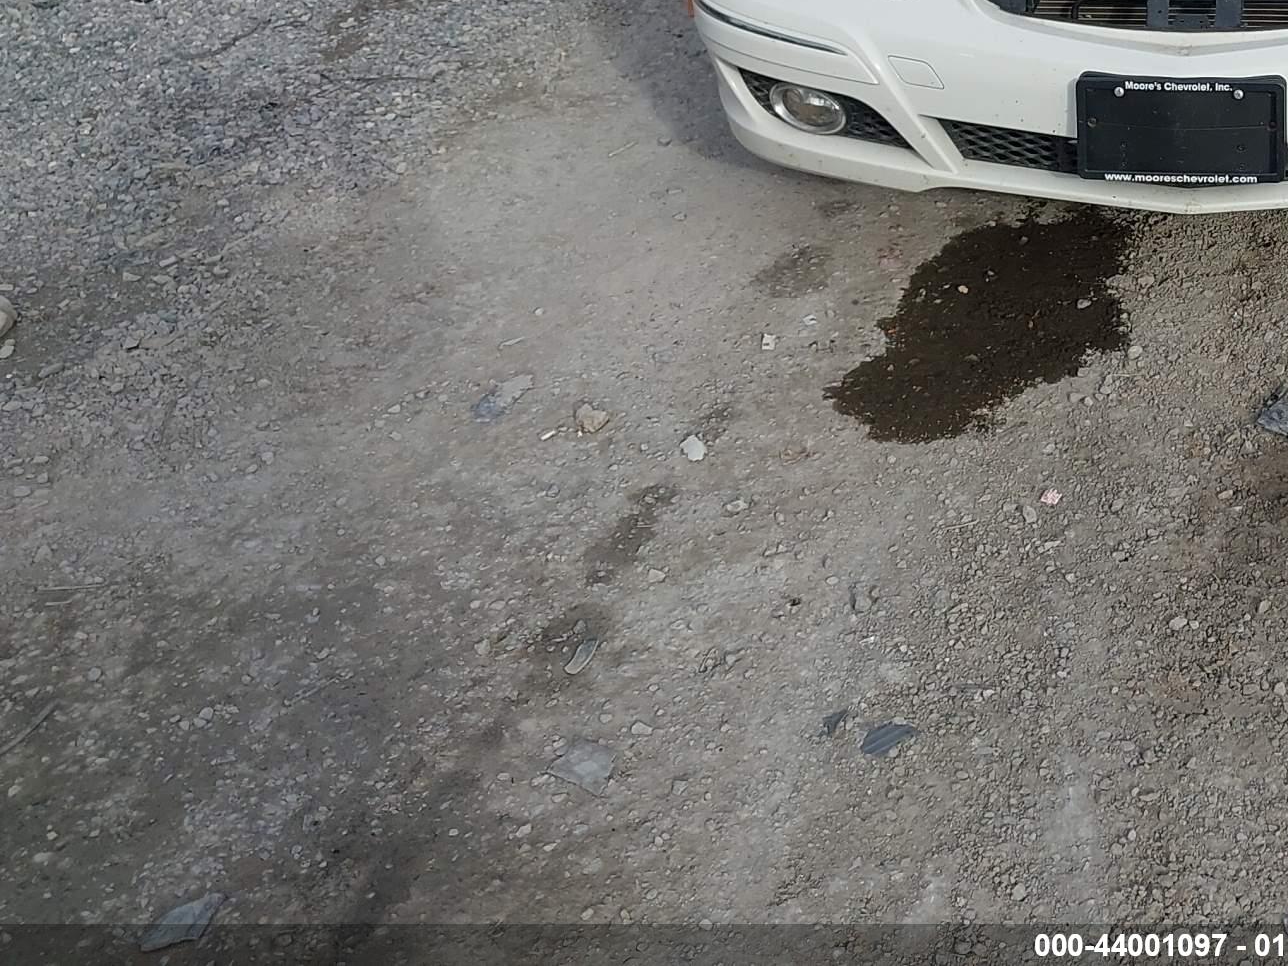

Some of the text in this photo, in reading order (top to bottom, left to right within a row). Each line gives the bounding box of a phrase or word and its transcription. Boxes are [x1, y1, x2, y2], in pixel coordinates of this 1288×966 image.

[1125, 81, 1162, 91] Moore's
[1215, 83, 1234, 92] Inc.
[1105, 173, 1258, 184] www.mooreschevrolet.com
